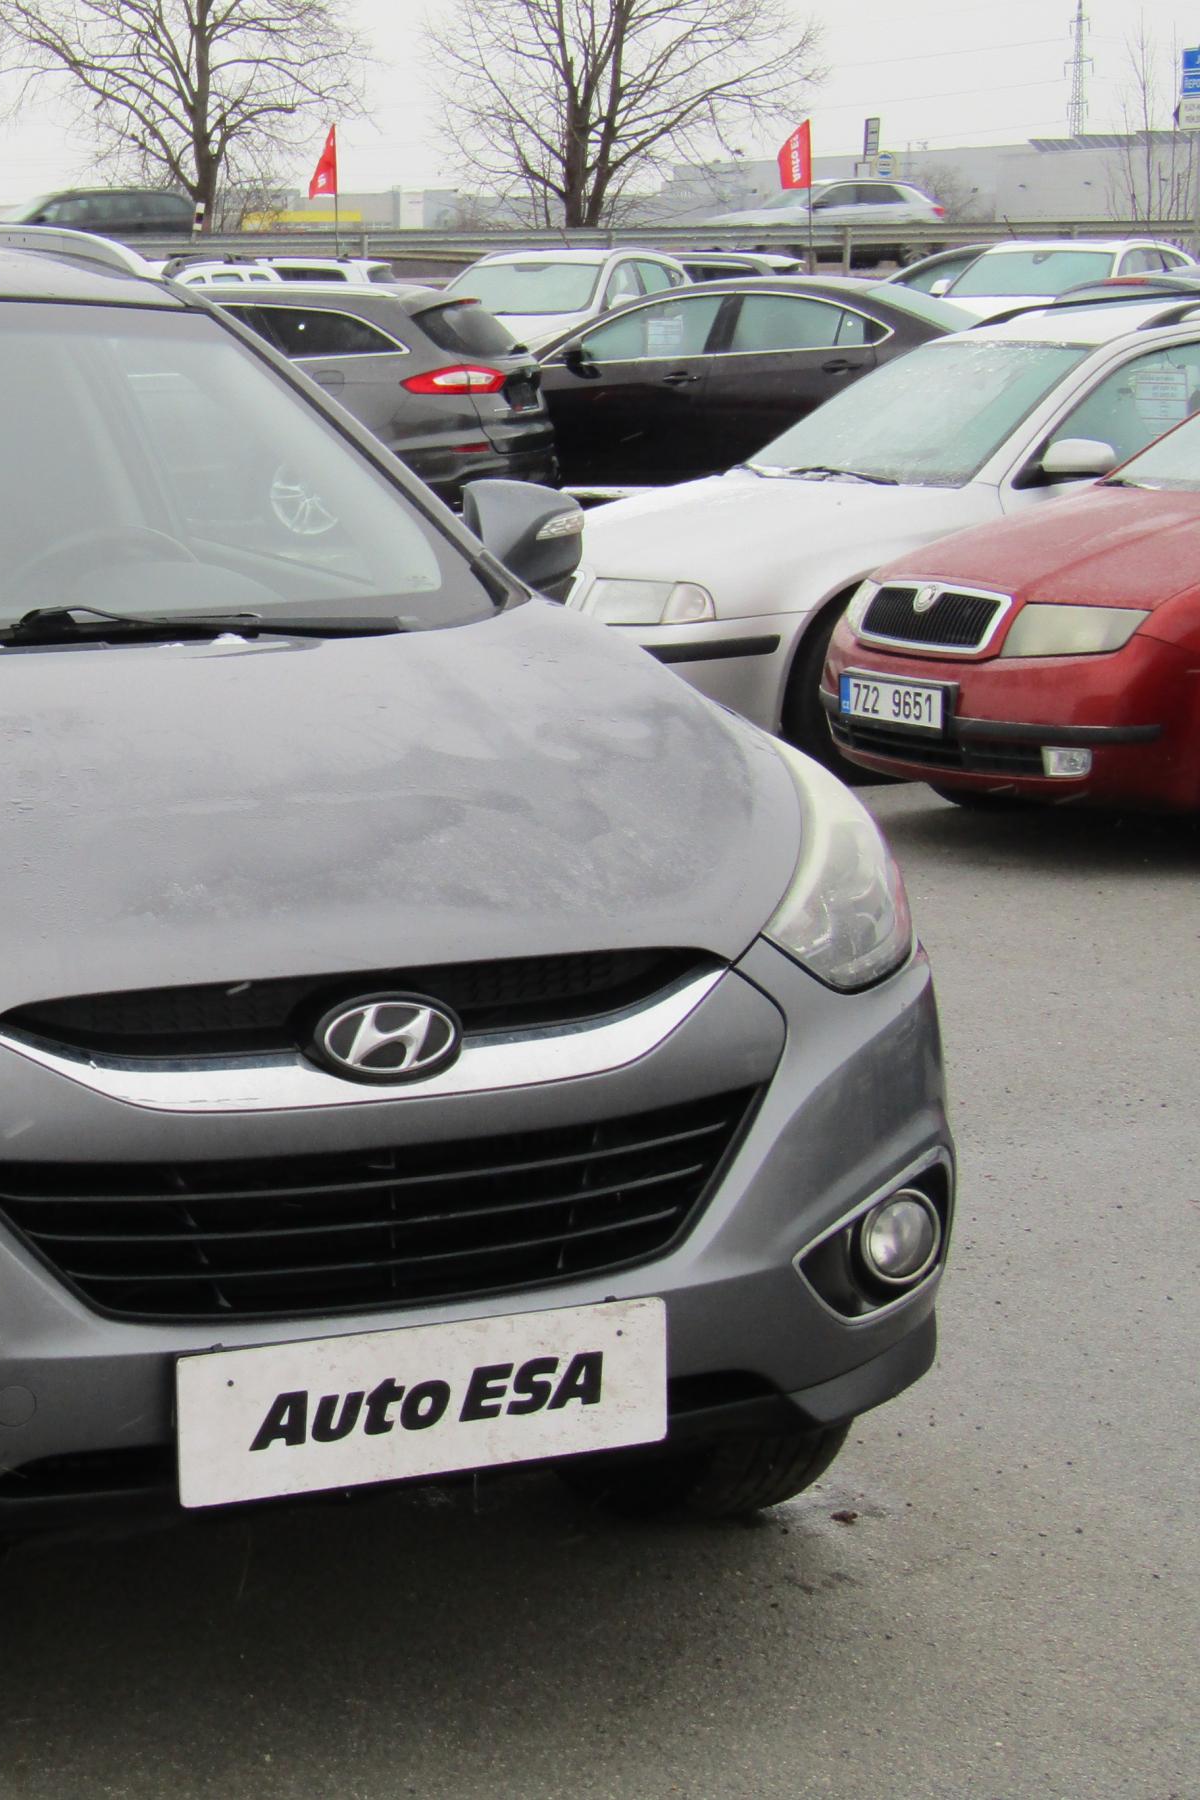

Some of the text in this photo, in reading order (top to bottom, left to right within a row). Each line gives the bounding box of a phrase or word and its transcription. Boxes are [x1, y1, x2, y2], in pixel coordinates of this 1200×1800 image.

[853, 683, 932, 723] 7Z2 9651
[249, 1350, 603, 1452] Auto ESA
